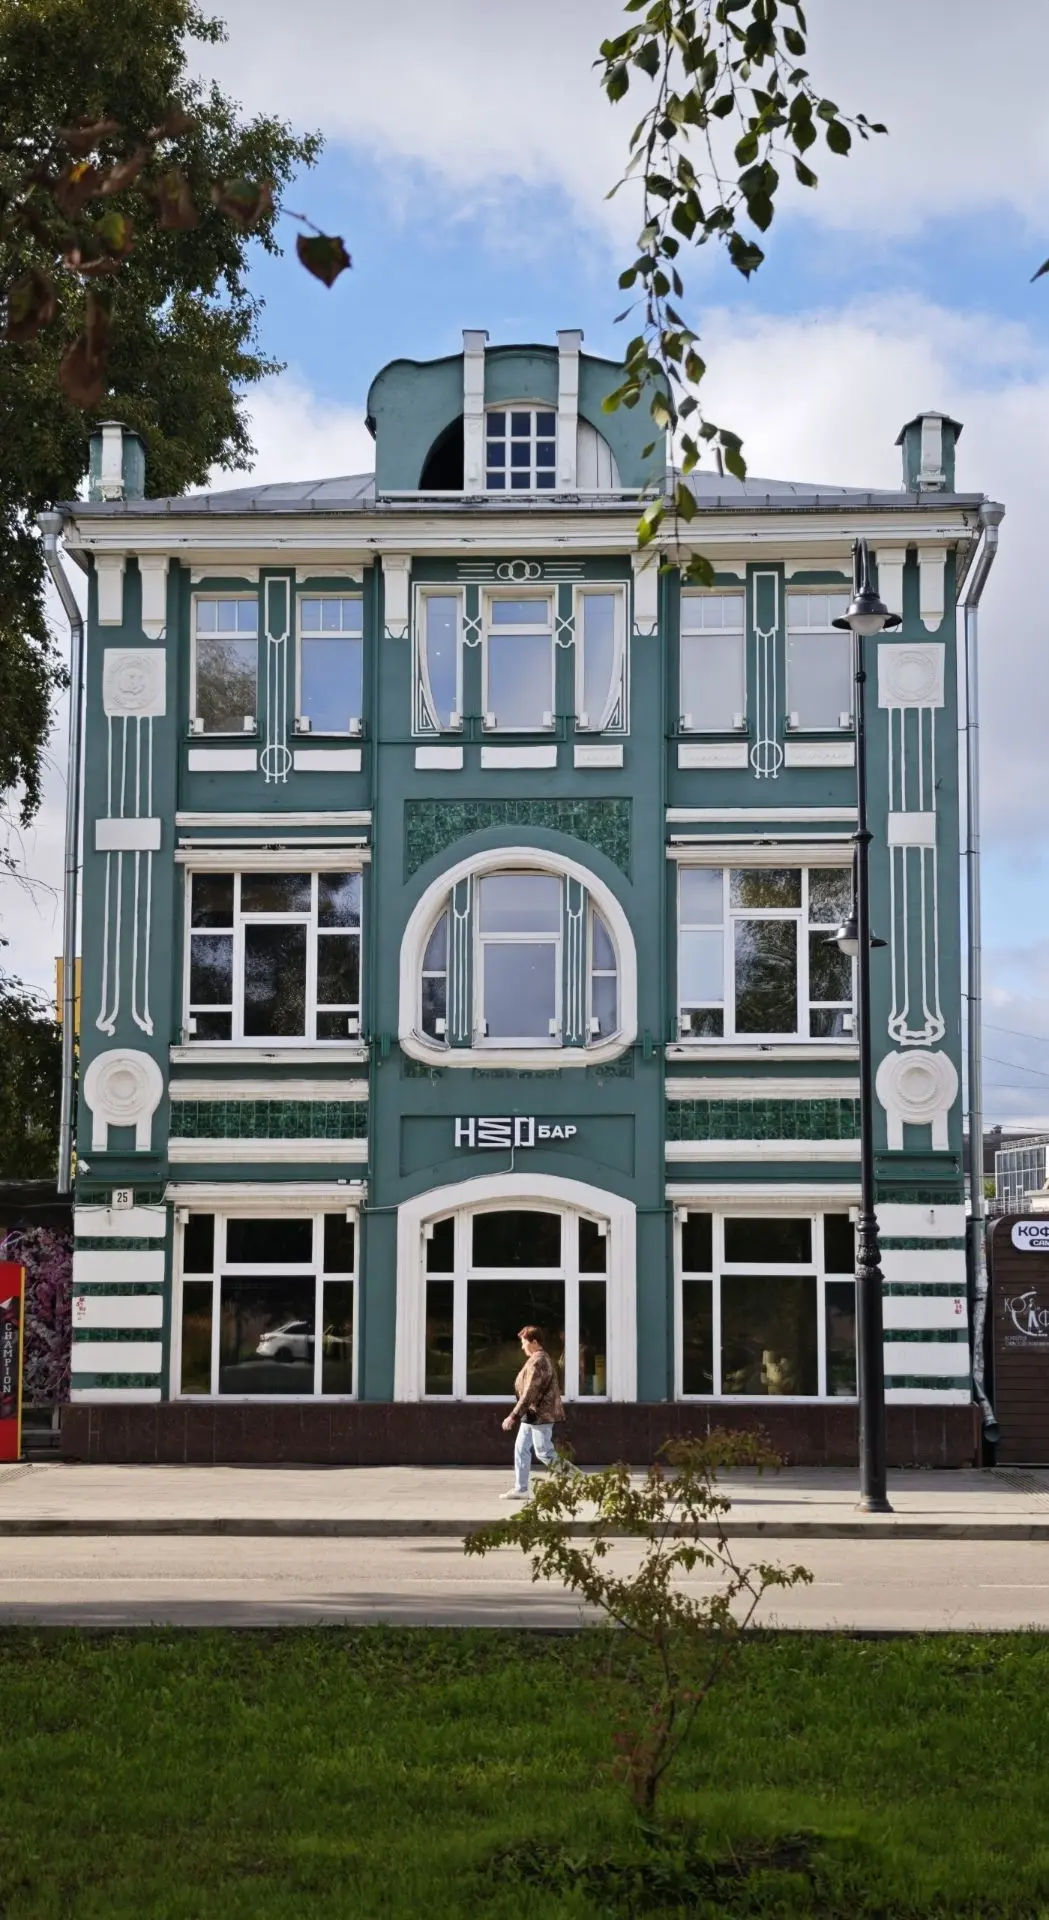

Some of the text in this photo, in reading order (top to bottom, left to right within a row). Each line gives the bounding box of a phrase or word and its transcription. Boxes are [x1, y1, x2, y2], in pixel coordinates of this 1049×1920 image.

[538, 1125, 577, 1138] БАР
[117, 1192, 128, 1203] 25
[3, 1322, 13, 1393] CHAMPION
